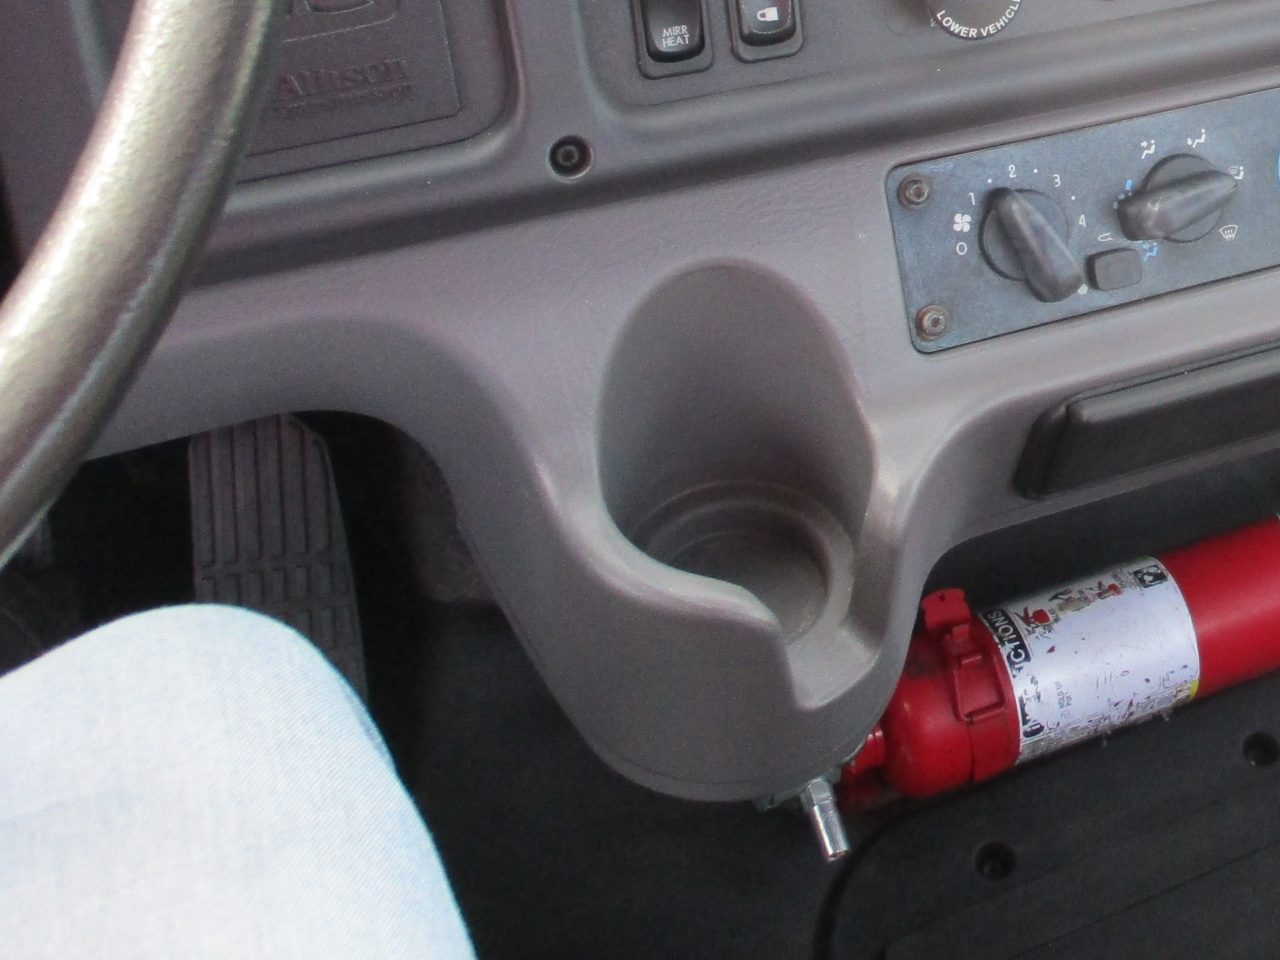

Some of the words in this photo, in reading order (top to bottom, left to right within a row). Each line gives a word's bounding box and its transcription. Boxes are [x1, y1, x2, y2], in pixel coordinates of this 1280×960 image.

[662, 25, 688, 37] MIRR
[936, 10, 977, 38] LOWER
[662, 35, 690, 48] HEAT
[1008, 164, 1017, 178] 2
[1053, 174, 1061, 187] 3
[968, 192, 976, 206] 1
[1078, 214, 1087, 228] 4
[956, 241, 968, 256] 0
